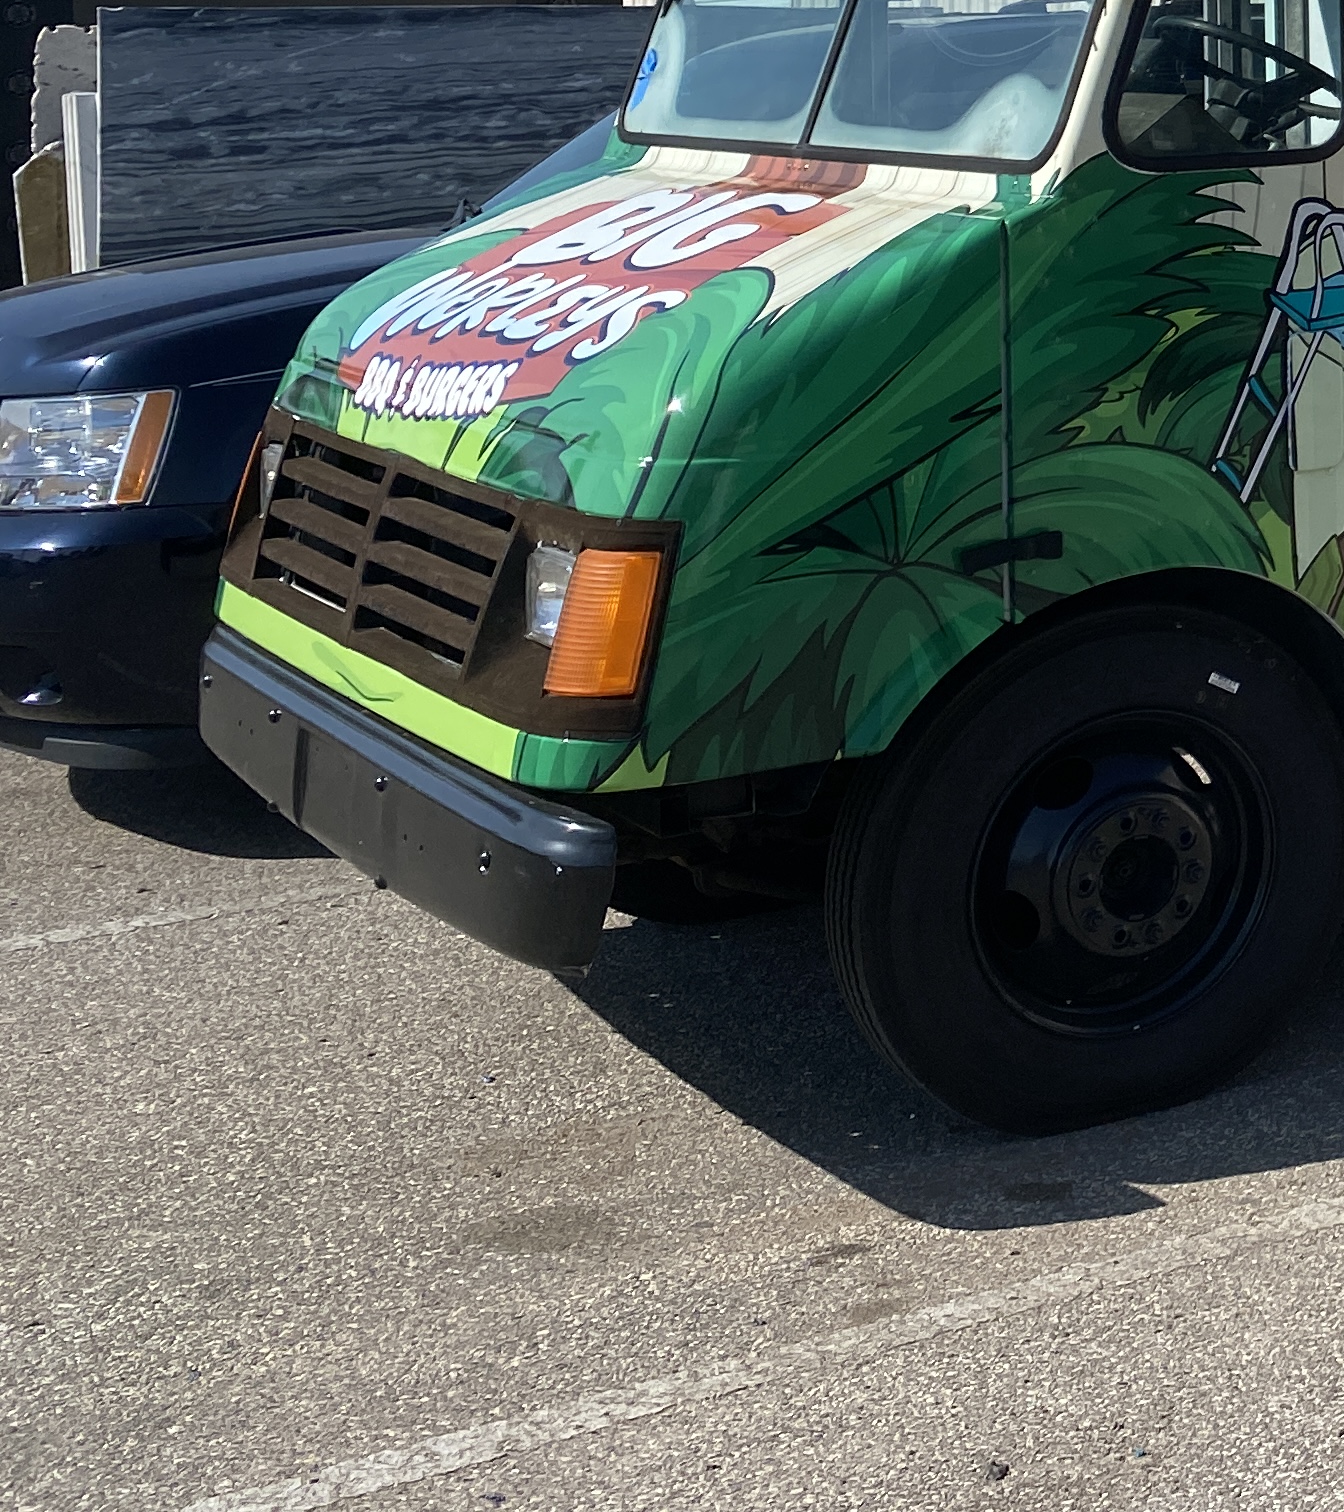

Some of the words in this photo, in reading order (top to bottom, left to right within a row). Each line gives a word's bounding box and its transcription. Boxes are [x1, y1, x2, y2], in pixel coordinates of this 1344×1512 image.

[510, 188, 826, 269] BIG
[350, 266, 689, 361] WORLEYS
[353, 354, 402, 418] BBQ
[402, 361, 520, 418] BURGERS
